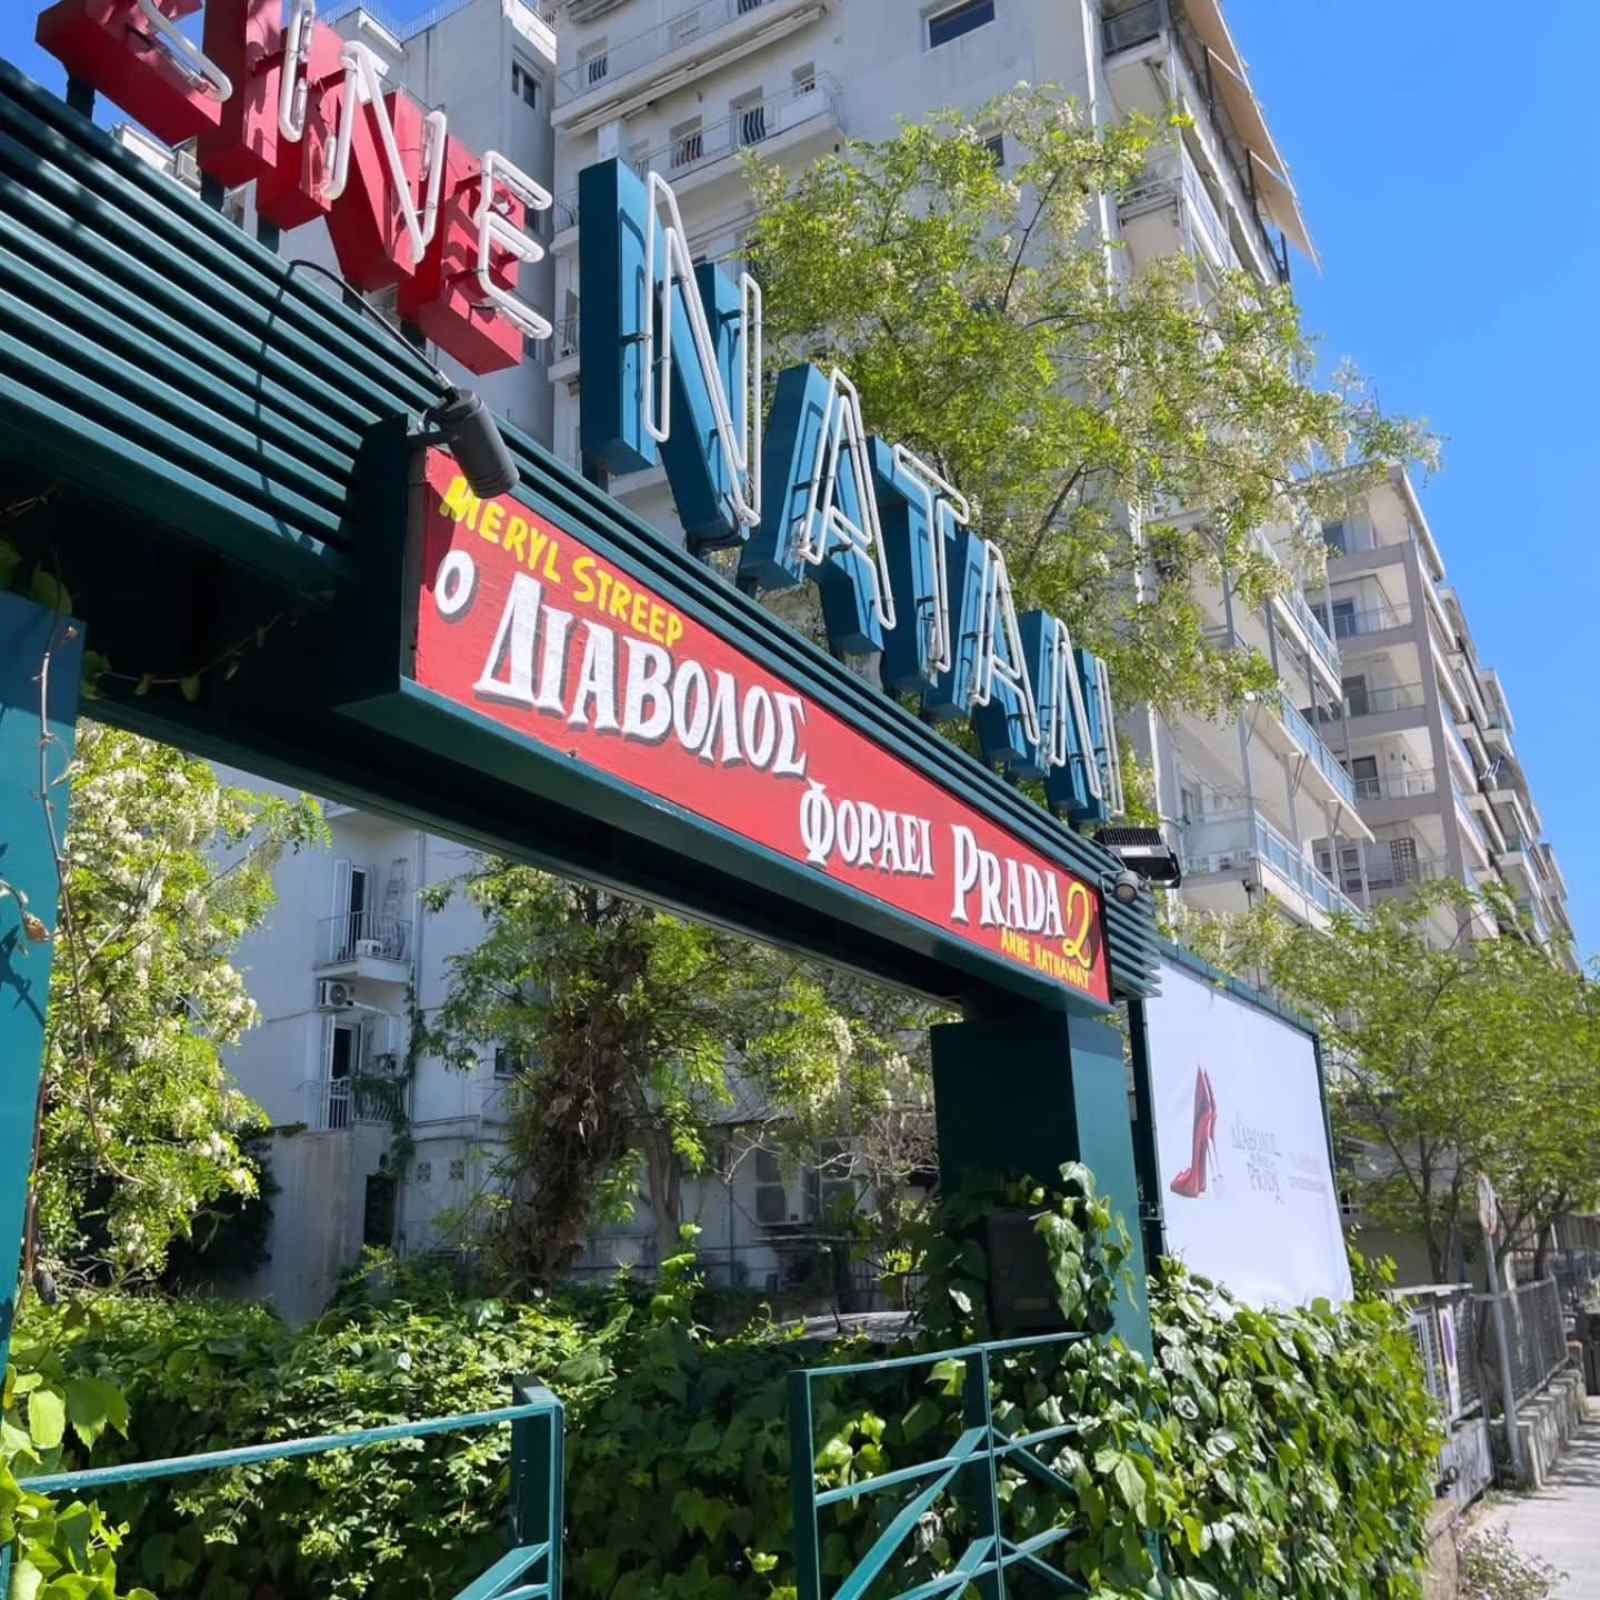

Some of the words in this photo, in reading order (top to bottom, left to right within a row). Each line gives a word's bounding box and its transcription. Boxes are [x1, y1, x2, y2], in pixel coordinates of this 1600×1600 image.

[440, 475, 561, 584] MERYL
[572, 556, 684, 648] STREEP
[434, 549, 476, 616] Ο
[472, 571, 807, 777] ΔΙΑΒΟΛΟΣ
[799, 778, 934, 877] ΦΟΡΑΕΙ
[951, 824, 1065, 938] PRADA
[1062, 880, 1093, 969] 2
